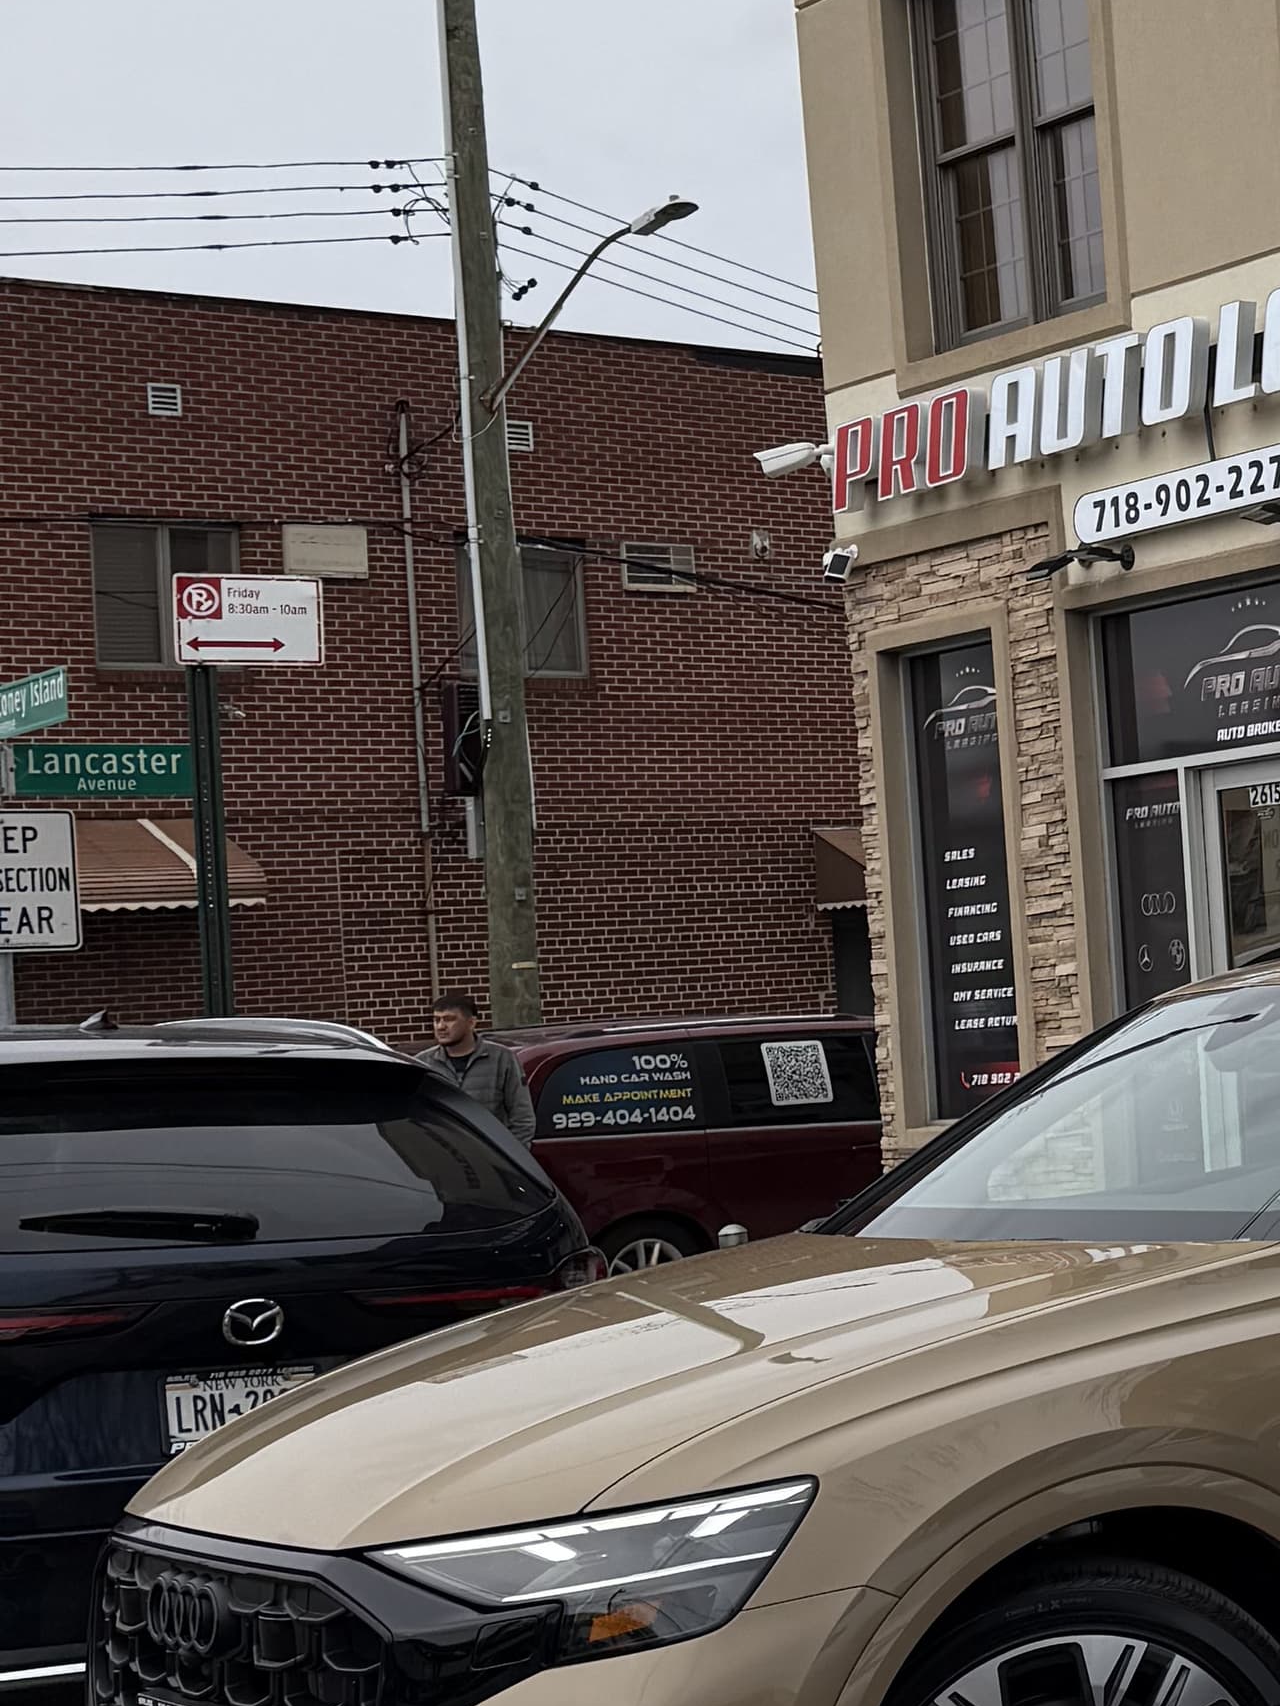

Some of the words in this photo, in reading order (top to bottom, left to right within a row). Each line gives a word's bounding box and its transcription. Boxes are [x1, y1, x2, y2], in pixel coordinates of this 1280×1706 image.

[833, 388, 985, 515] PRO
[988, 315, 1209, 472] AUTO
[226, 586, 261, 600] Friday
[227, 602, 269, 616] 8:30am
[279, 603, 307, 616] 10am
[0, 688, 26, 718] oney
[30, 669, 64, 708] Island
[1201, 671, 1246, 701] PRO
[1217, 725, 1245, 741] AUTO
[27, 748, 182, 775] Lancaster
[77, 777, 137, 791] Avenue
[1250, 784, 1280, 806] 2615
[944, 848, 975, 862] SALES
[946, 875, 986, 890] LEASING
[948, 902, 998, 918] FINANCING
[949, 934, 975, 946] USED
[976, 930, 1002, 943] CARS
[951, 959, 1004, 974] INSURANCE
[953, 991, 972, 1002] DMV
[974, 987, 1014, 1000] SERVICE
[954, 1017, 986, 1030] LEASE
[631, 1053, 688, 1070] 100%
[580, 1072, 618, 1086] HAND
[620, 1071, 650, 1084] CAR
[652, 1069, 691, 1082] WASH
[562, 1093, 601, 1106] MAKE
[603, 1087, 693, 1104] APPOINTMENT
[552, 1105, 696, 1129] 929-404-1404
[203, 1378, 236, 1392] NEW
[241, 1374, 283, 1389] YORK
